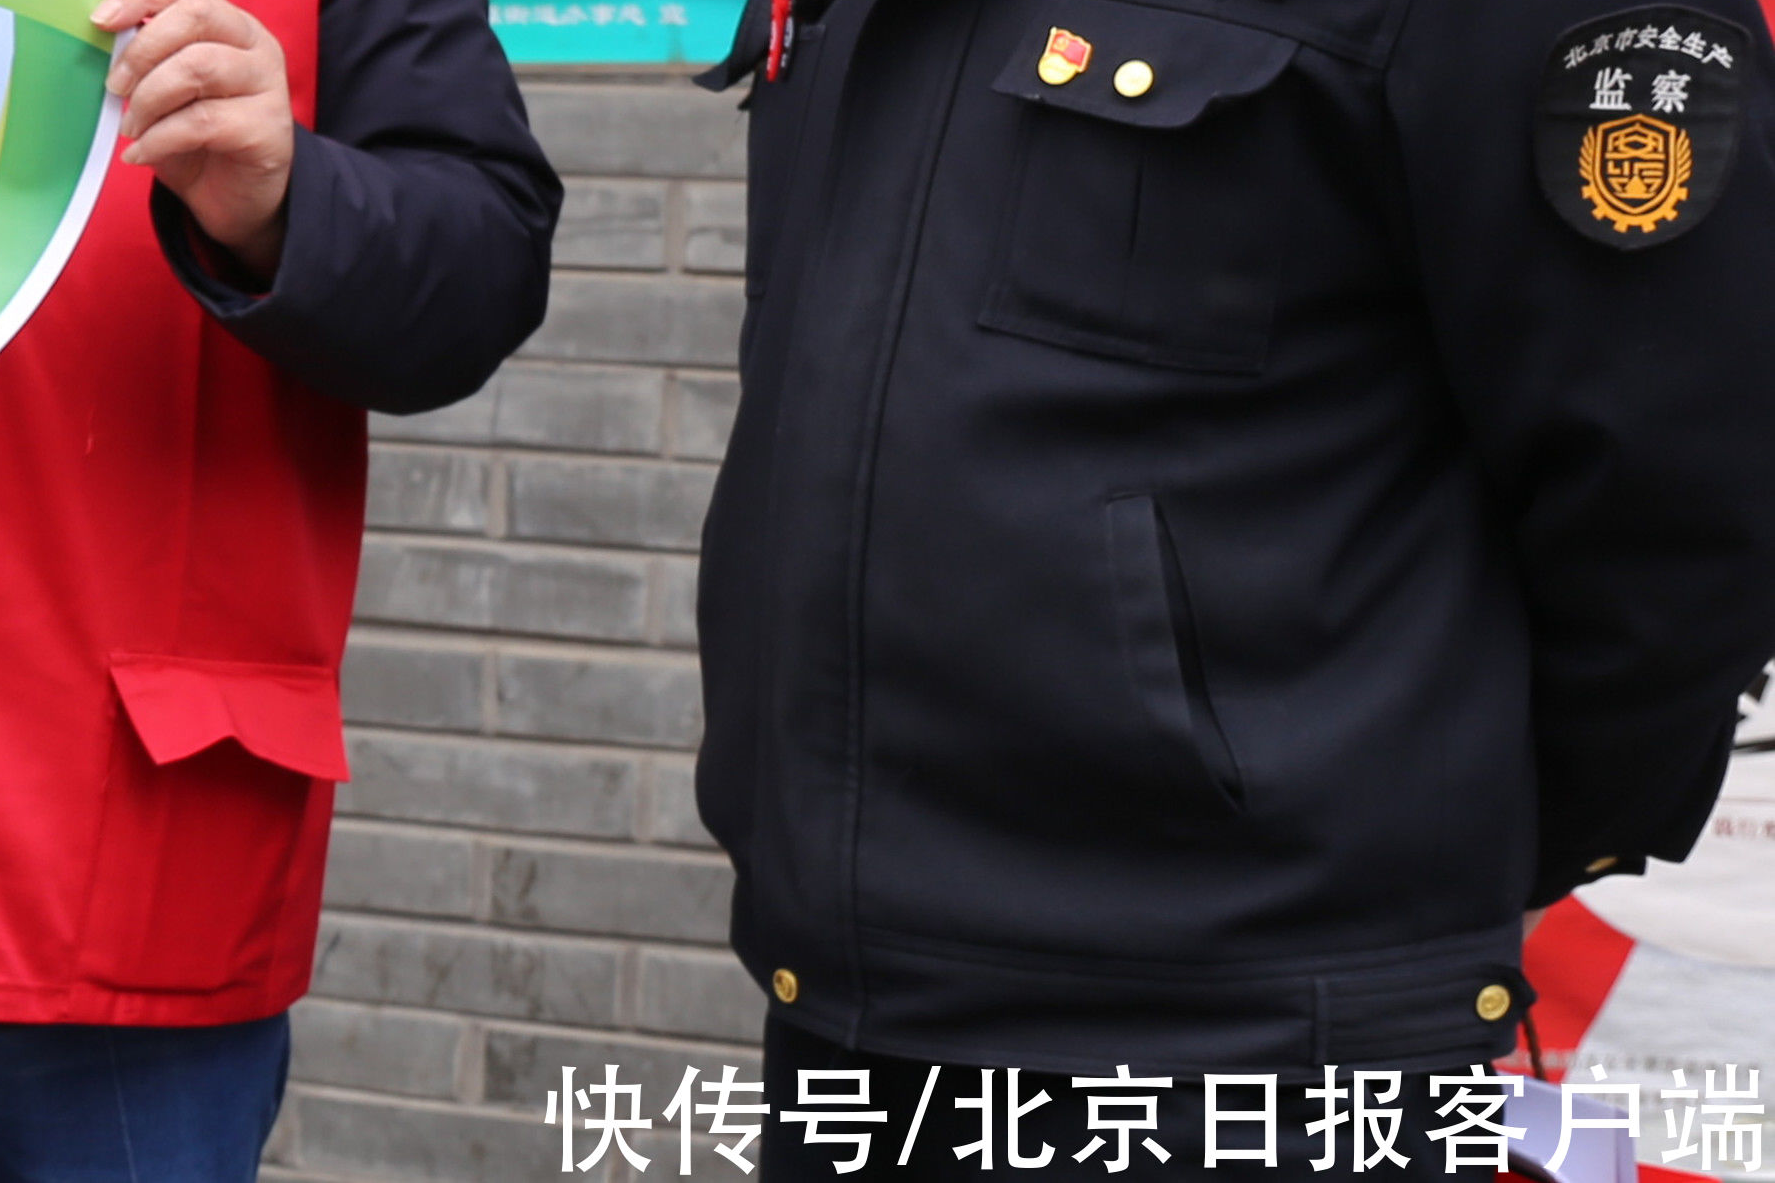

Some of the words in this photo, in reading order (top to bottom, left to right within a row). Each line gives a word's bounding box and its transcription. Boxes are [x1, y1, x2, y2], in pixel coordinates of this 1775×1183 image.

[1564, 24, 1734, 69] 北京市安全生产
[1589, 67, 1692, 114] 监察
